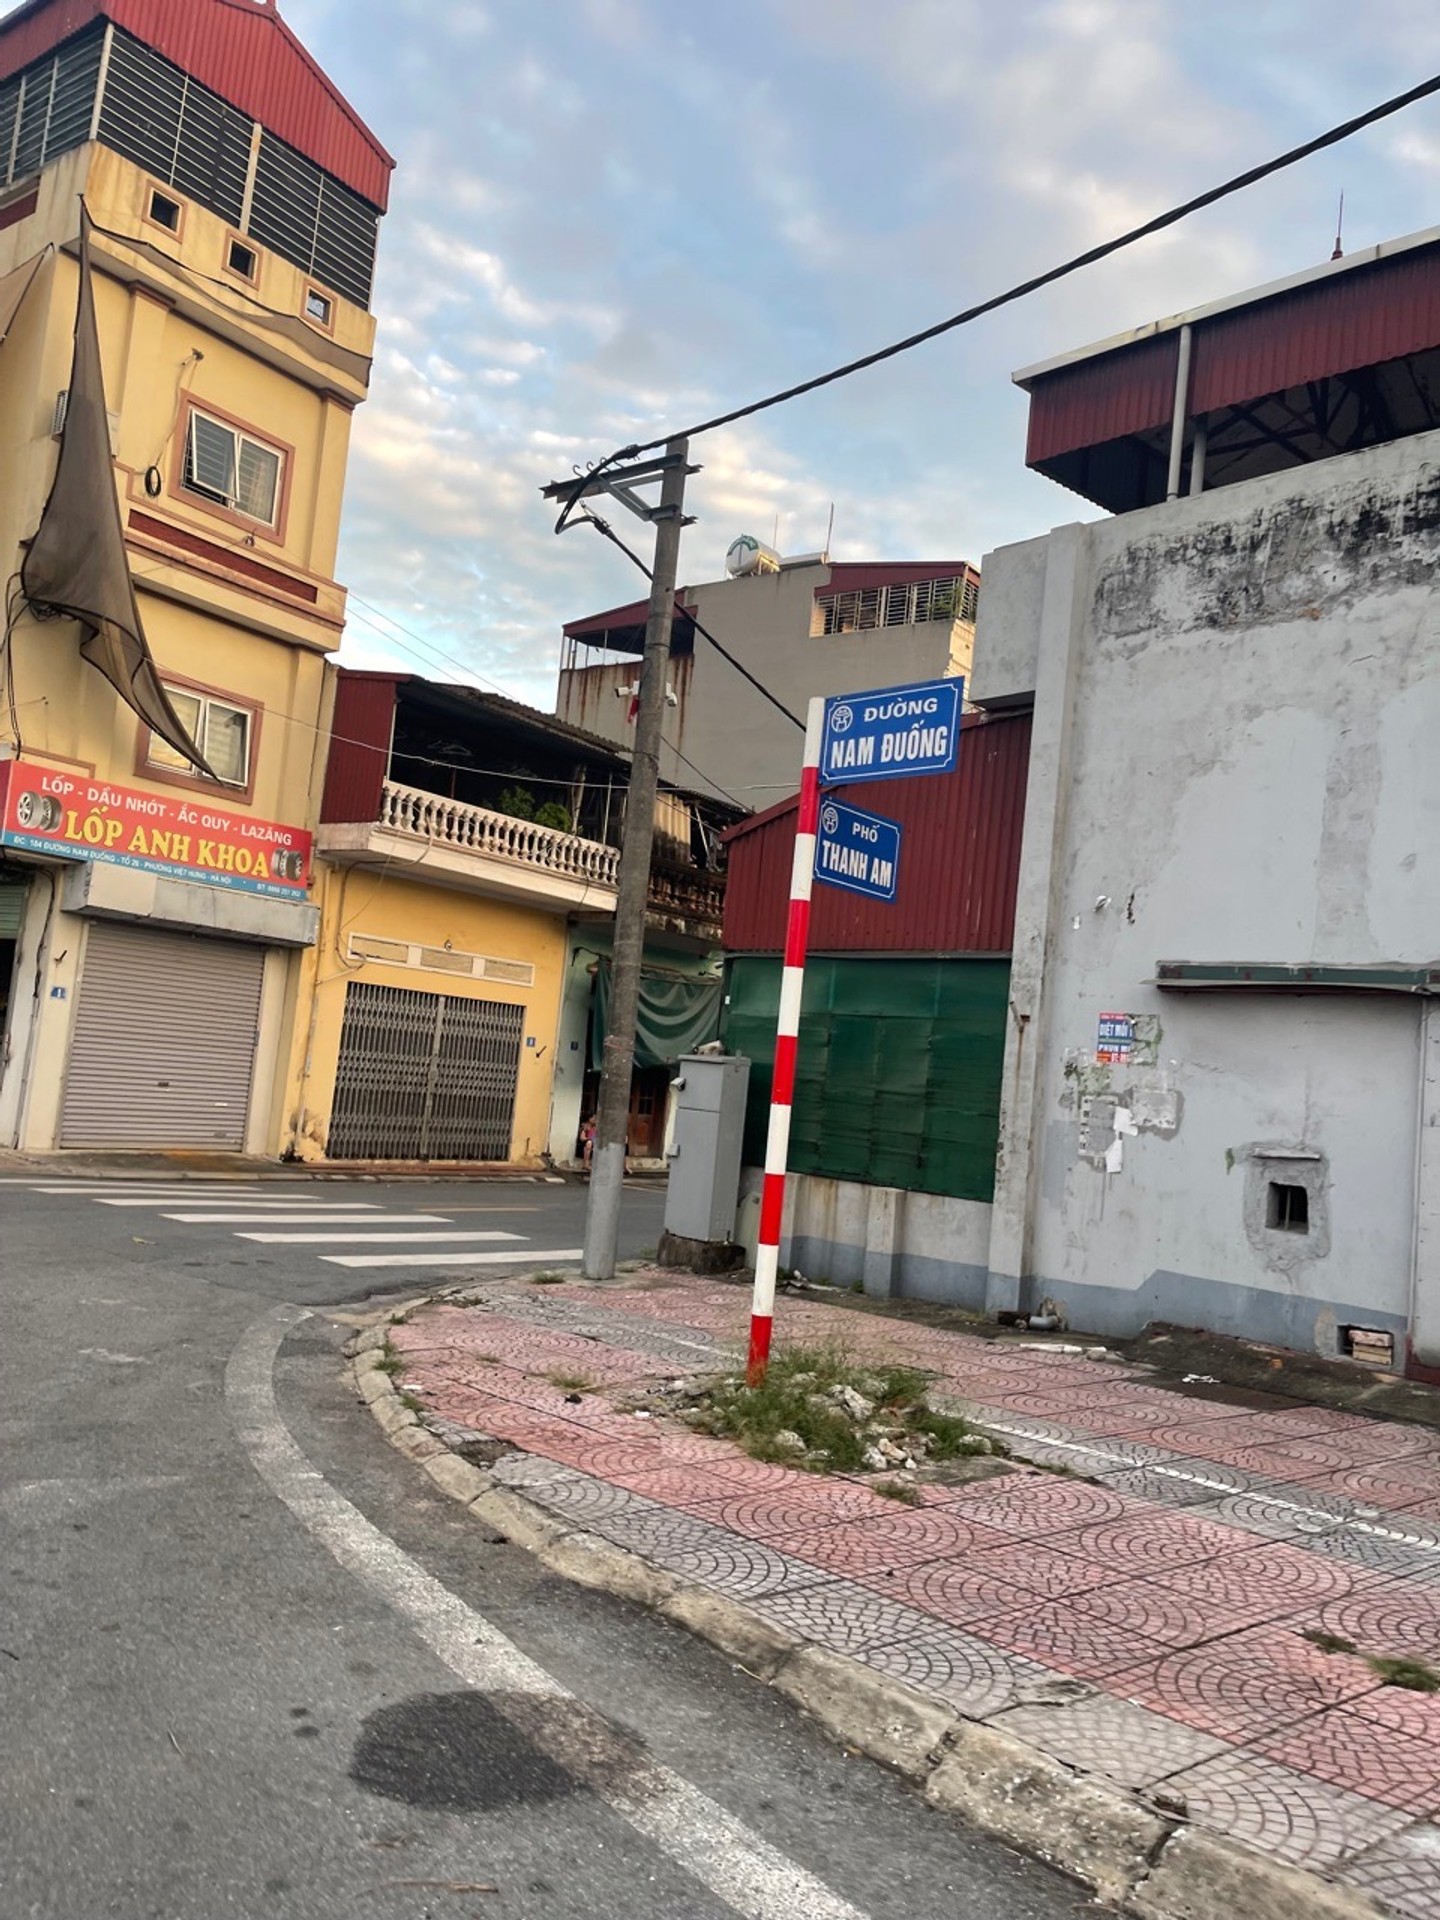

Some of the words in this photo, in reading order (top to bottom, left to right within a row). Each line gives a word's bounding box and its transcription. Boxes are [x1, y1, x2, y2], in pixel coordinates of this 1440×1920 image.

[864, 698, 938, 722] ĐƯỜNG
[831, 736, 875, 769] NAM
[880, 719, 948, 763] ĐUỐNG
[42, 775, 74, 795] LỐP
[87, 786, 122, 807] DẦU
[126, 799, 167, 817] NHỚT
[177, 803, 198, 824] ẮC
[201, 815, 231, 831] QUY
[65, 806, 123, 847] LỐP
[128, 825, 191, 862] ANH
[197, 839, 270, 878] KHOA
[852, 822, 880, 843] PHỐ
[822, 840, 868, 880] THANH
[870, 857, 892, 888] AM
